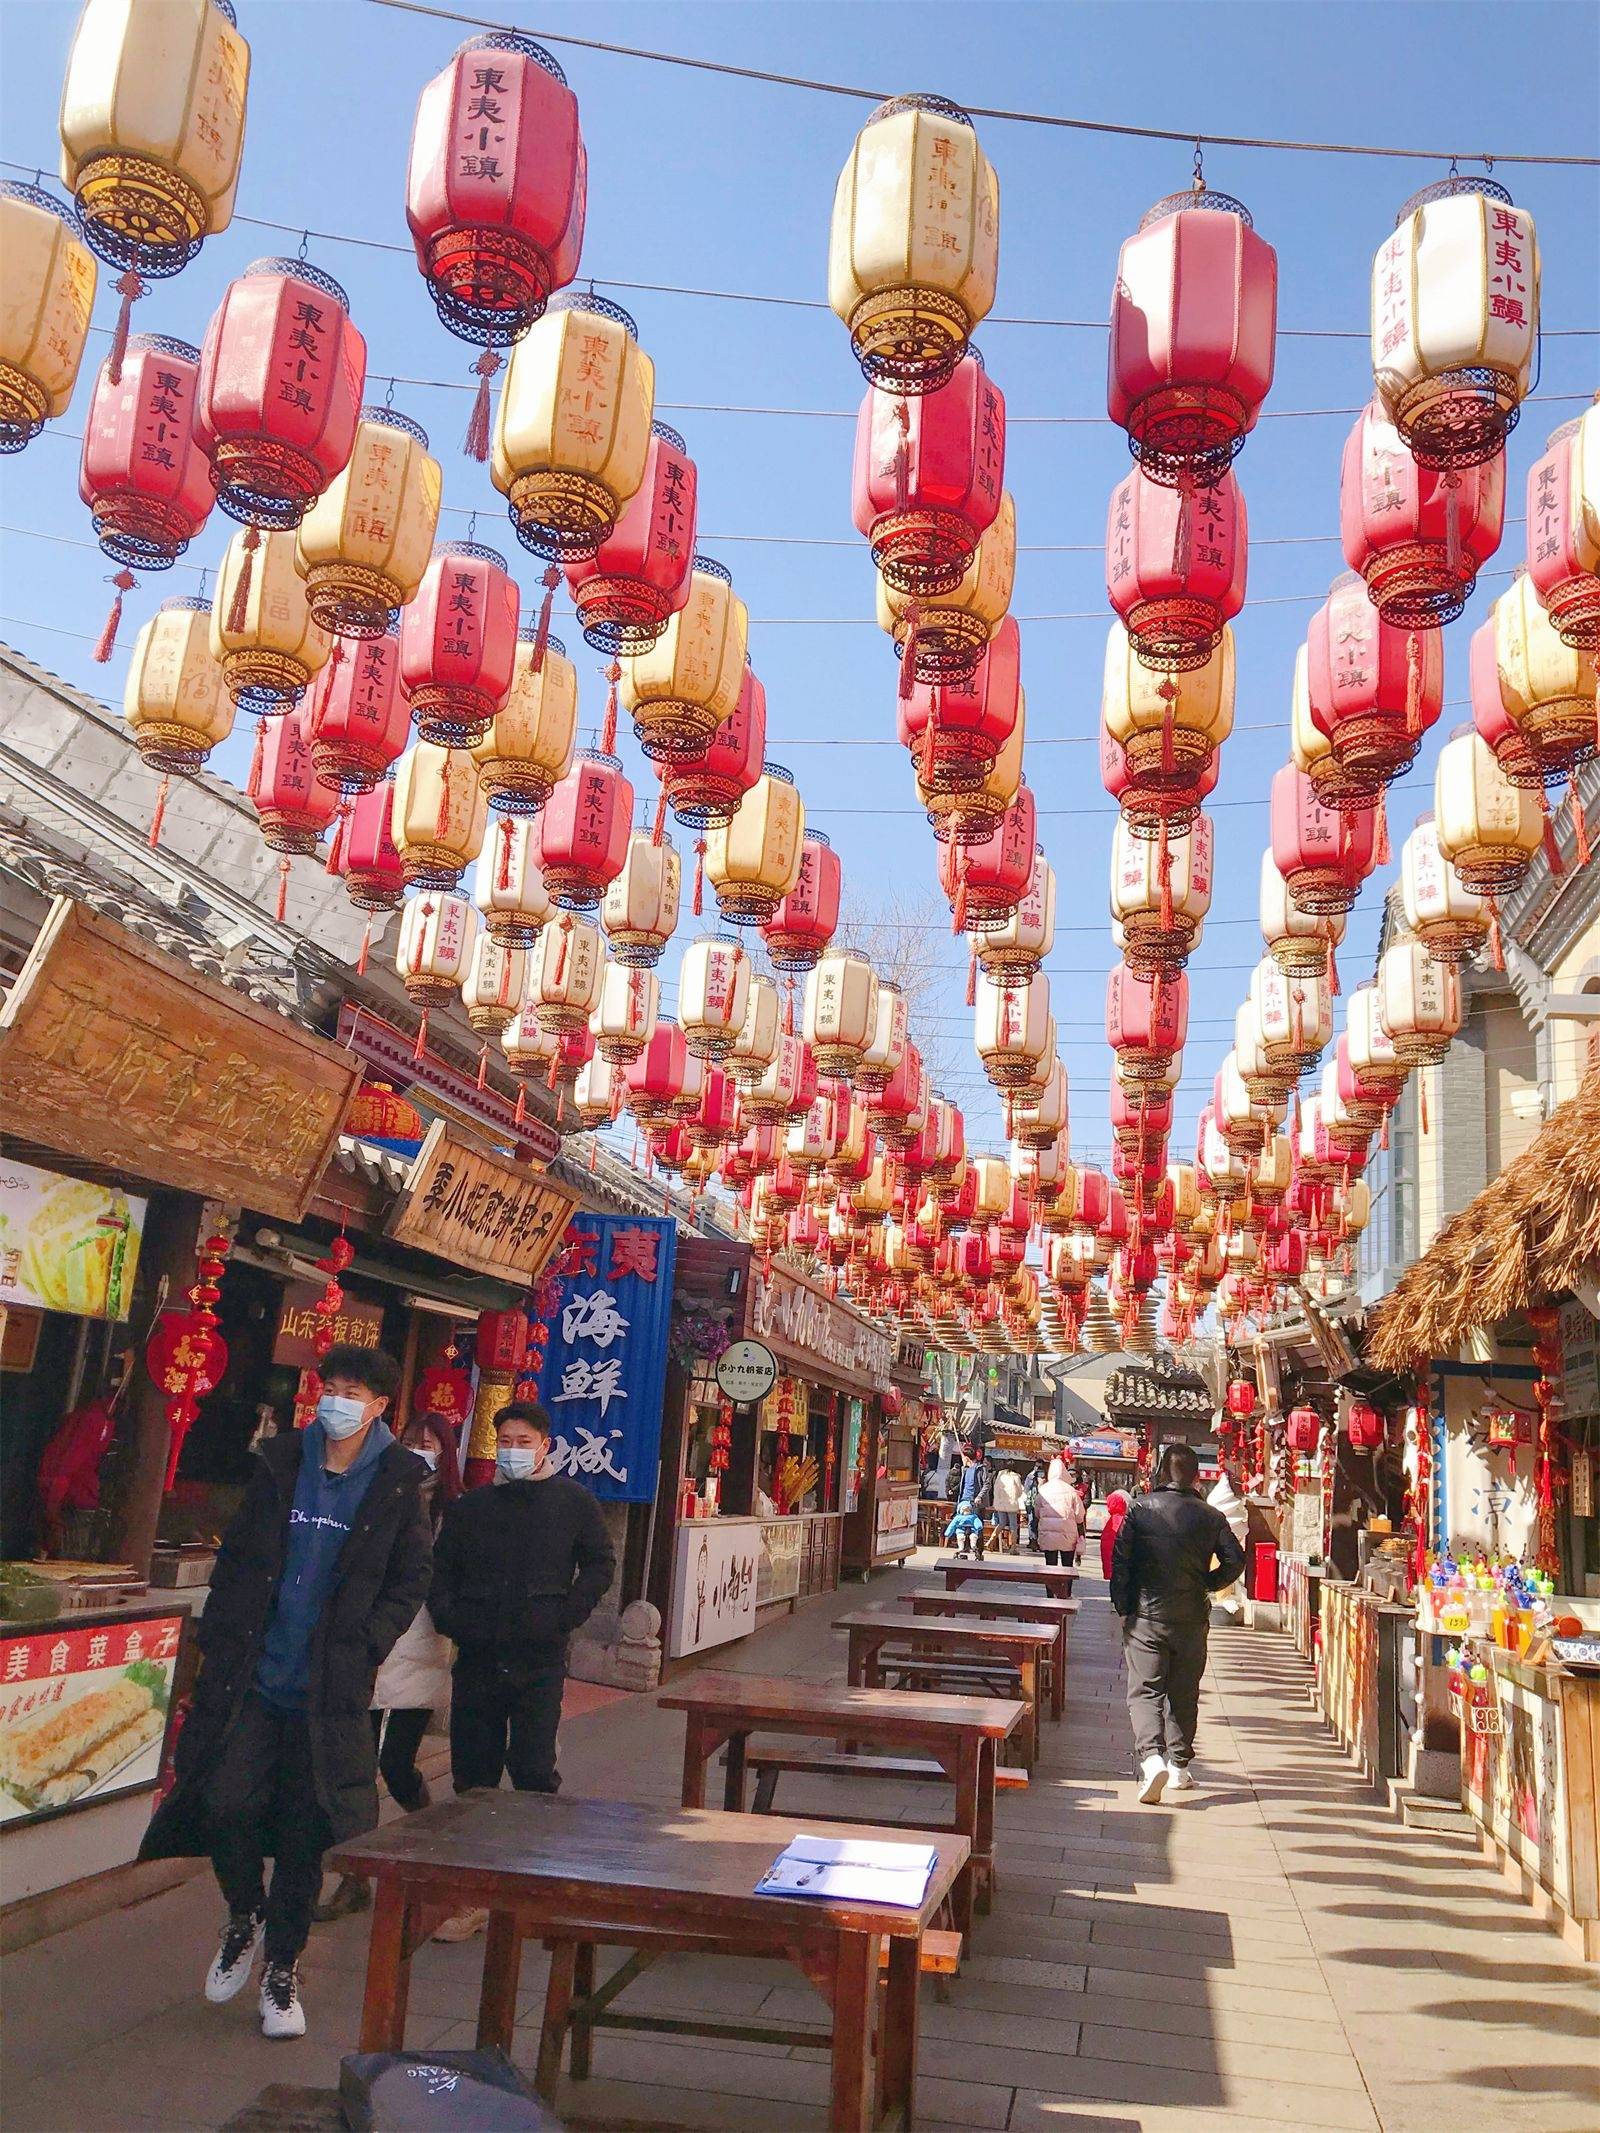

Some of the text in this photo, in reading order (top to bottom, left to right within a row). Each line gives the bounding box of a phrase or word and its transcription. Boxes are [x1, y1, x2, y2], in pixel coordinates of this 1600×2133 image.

[459, 66, 508, 184] 東夷小鎮
[1379, 236, 1411, 362] 東夷小鎮
[1489, 207, 1528, 331] 東夷小鎮
[277, 299, 327, 415] 東夷小鎮
[142, 370, 184, 472] 東夷小鎮
[656, 460, 687, 563] 東夷小鎮
[1113, 486, 1132, 584] 東夷小鎮
[1536, 463, 1563, 563] 東夷小鎮
[442, 571, 479, 662] 東夷小鎮
[355, 644, 388, 724] 東夷小鎮
[579, 775, 607, 847] 東夷小鎮
[1005, 795, 1026, 870] 東夷小鎮
[664, 858, 676, 916] 東夷小鎮
[1191, 817, 1209, 897] 東夷小鎮
[437, 902, 460, 962] 東夷小鎮
[482, 944, 498, 990] 東夷小鎮
[574, 938, 592, 996] 東夷小鎮
[706, 950, 728, 1009] 東夷小鎮
[819, 973, 836, 1025] 東夷小鎮
[1420, 957, 1437, 1013] 東夷小鎮
[778, 1040, 794, 1089] 東夷小鎮
[4, 1626, 177, 1681] 美食菜盒子
